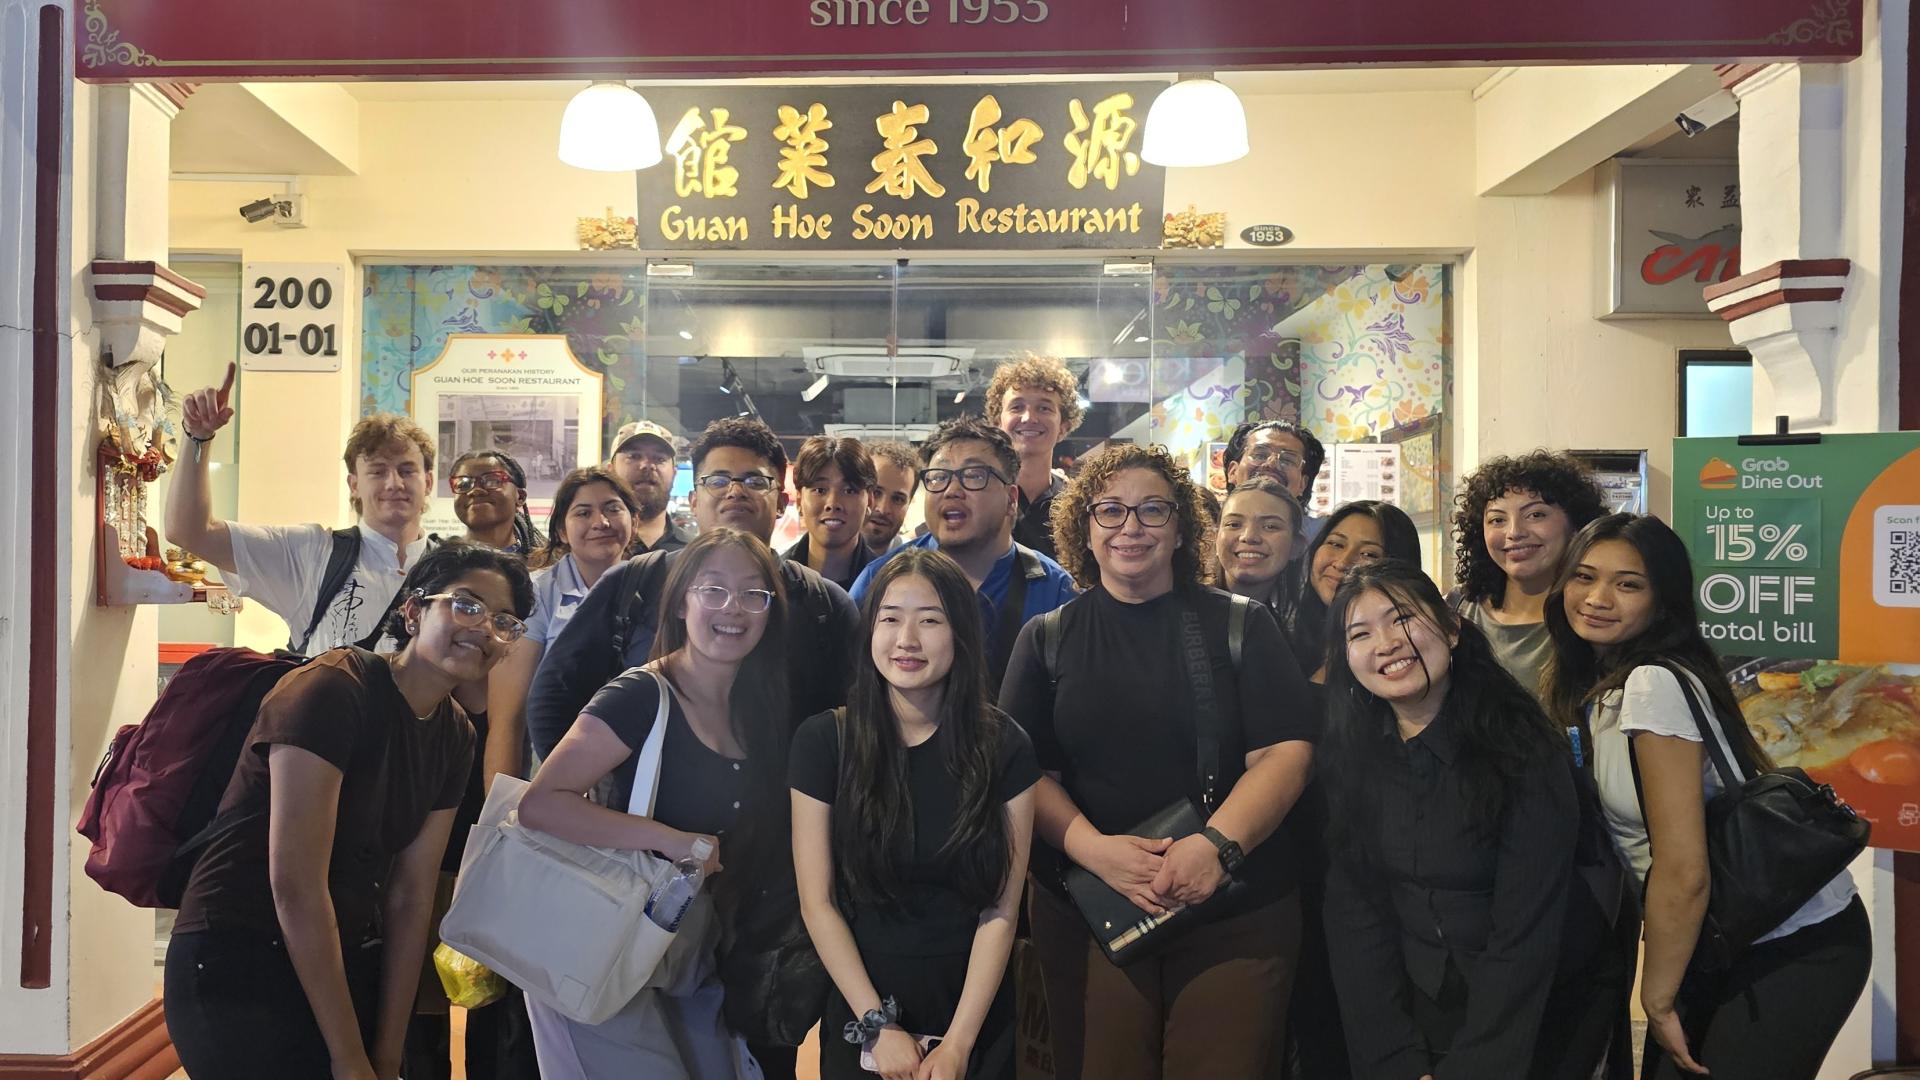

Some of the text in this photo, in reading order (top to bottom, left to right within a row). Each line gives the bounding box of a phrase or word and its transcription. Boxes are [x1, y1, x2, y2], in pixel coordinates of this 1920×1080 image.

[810, 0, 1049, 26] since 1953
[660, 197, 1143, 241] Guan Hoe Soon Restaurant
[1250, 231, 1284, 242] 1953
[253, 276, 332, 309] 200
[244, 322, 338, 356] 01-01
[433, 376, 461, 384] GUAN
[1742, 456, 1790, 472] Grab
[1742, 474, 1823, 489] Dine Out
[1706, 505, 1754, 522] Up to
[1887, 516, 1913, 524] Scan
[1706, 524, 1808, 561] 15%
[1700, 573, 1816, 615] OFF
[1699, 620, 1817, 643] total bill
